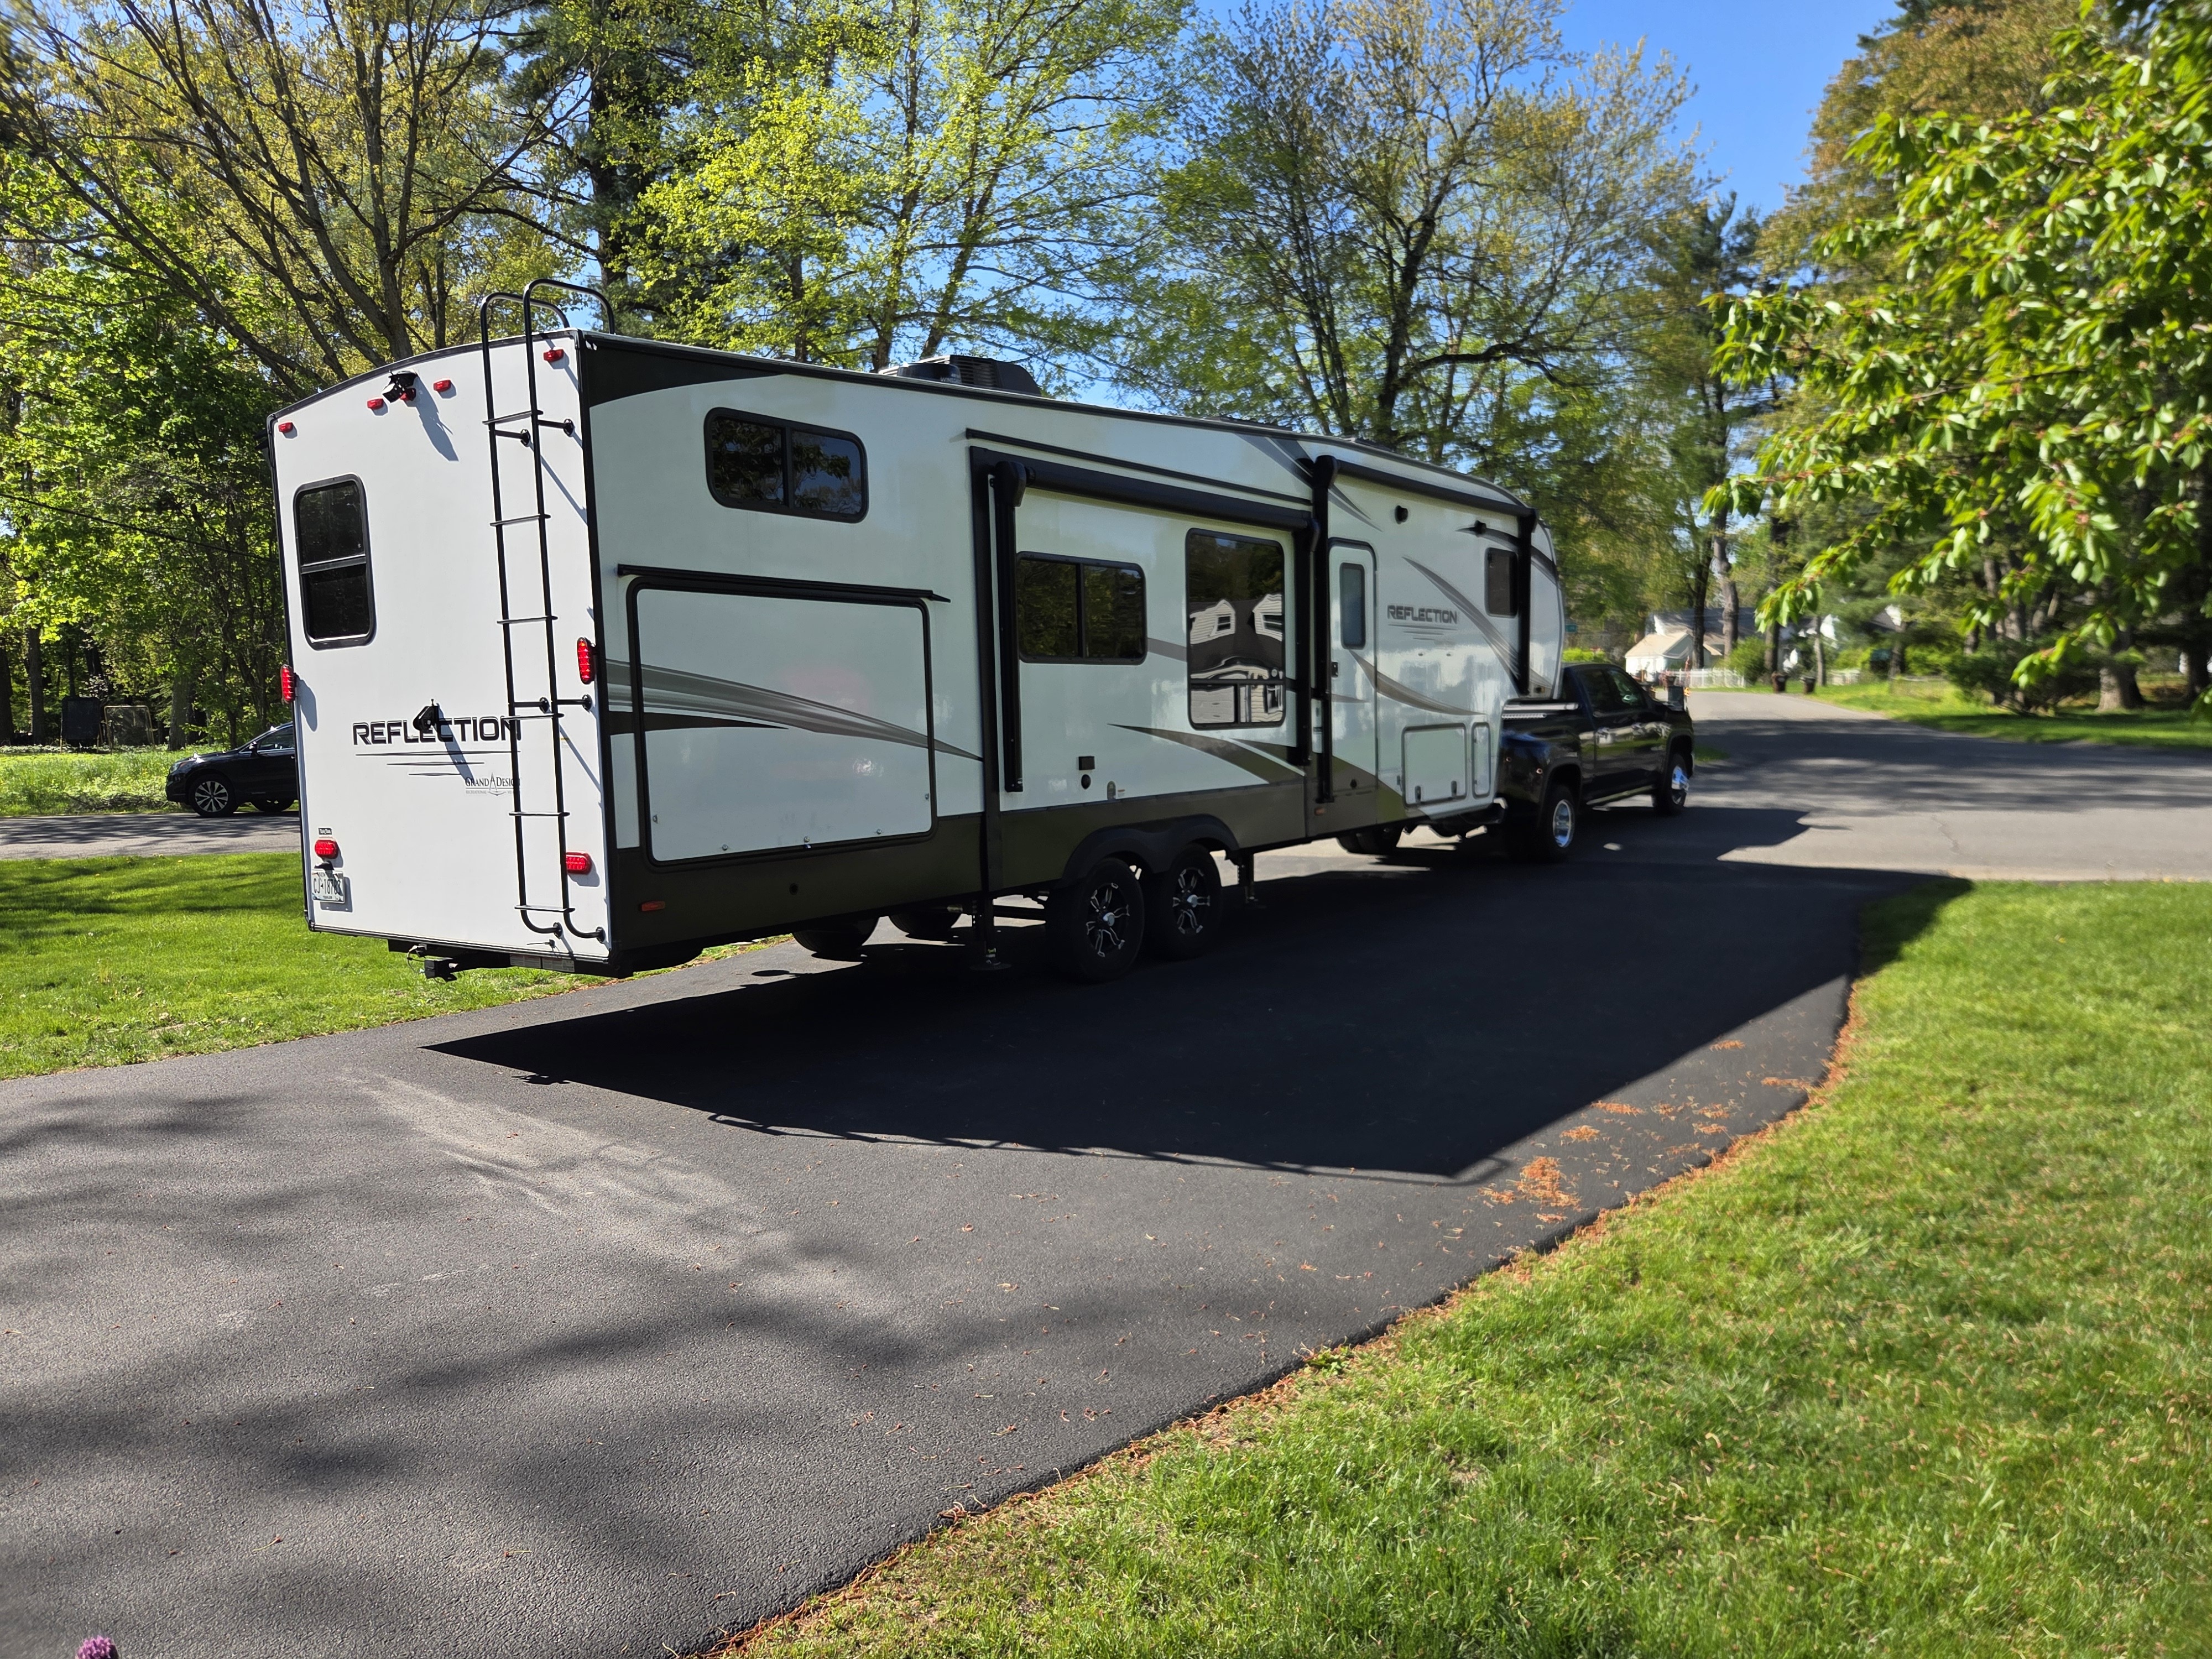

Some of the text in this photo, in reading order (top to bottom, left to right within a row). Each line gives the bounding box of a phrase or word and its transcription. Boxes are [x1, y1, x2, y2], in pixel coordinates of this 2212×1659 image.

[1387, 605, 1458, 624] REFLECTION
[353, 716, 521, 745] REFLECTION
[465, 776, 520, 786] GRAND DESIG
